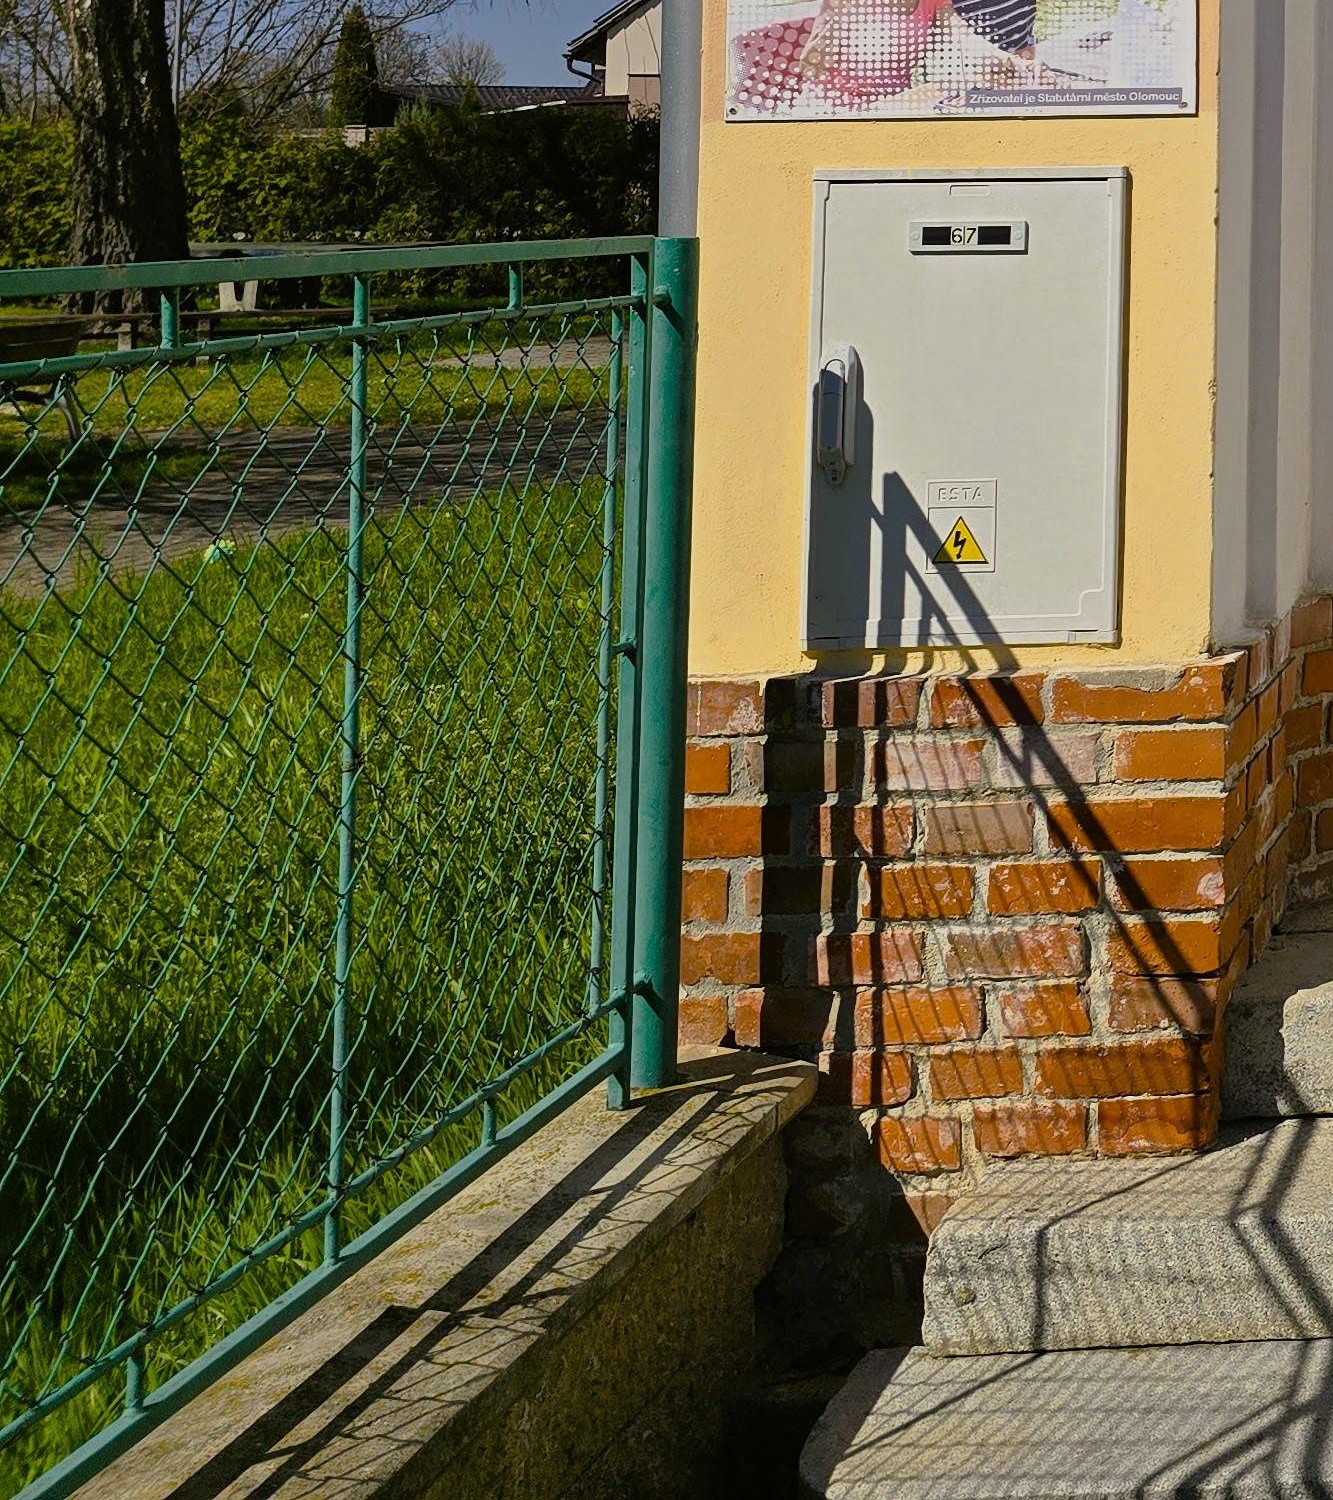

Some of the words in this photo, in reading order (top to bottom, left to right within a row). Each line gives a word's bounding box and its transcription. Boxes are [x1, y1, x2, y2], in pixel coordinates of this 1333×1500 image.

[969, 93, 1023, 104] Zřizovatel
[1024, 94, 1036, 105] je
[1037, 92, 1091, 102] Statutární
[1093, 93, 1126, 102] město
[1128, 91, 1180, 101] Olomouc
[951, 228, 977, 243] 67
[938, 487, 984, 501] ESTA
